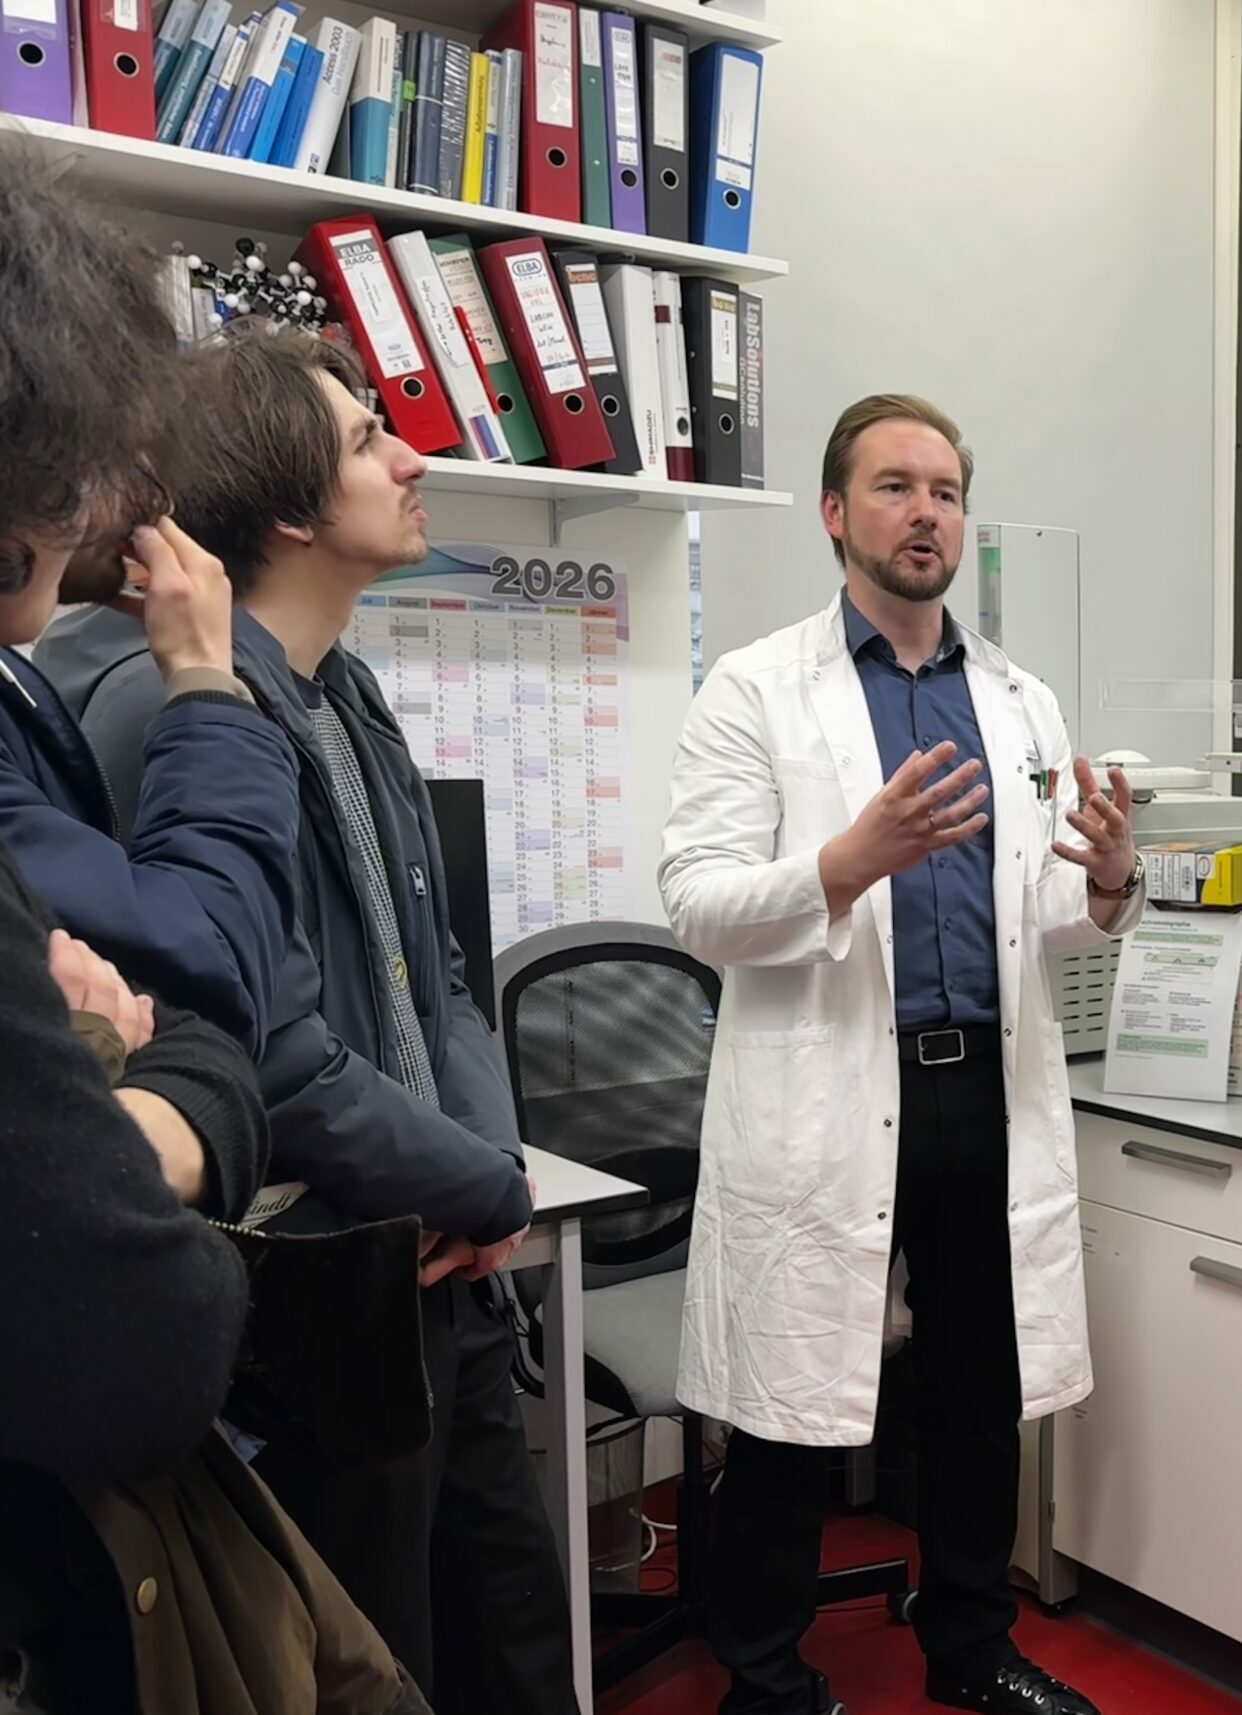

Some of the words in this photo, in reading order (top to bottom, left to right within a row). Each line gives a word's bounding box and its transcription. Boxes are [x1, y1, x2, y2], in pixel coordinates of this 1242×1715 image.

[325, 47, 339, 84] Access
[332, 26, 344, 48] 2003
[340, 243, 371, 257] ELBA
[344, 254, 375, 267] RADO
[516, 262, 539, 273] ELBA
[746, 302, 761, 428] LabSolutions
[491, 557, 615, 600] 2026
